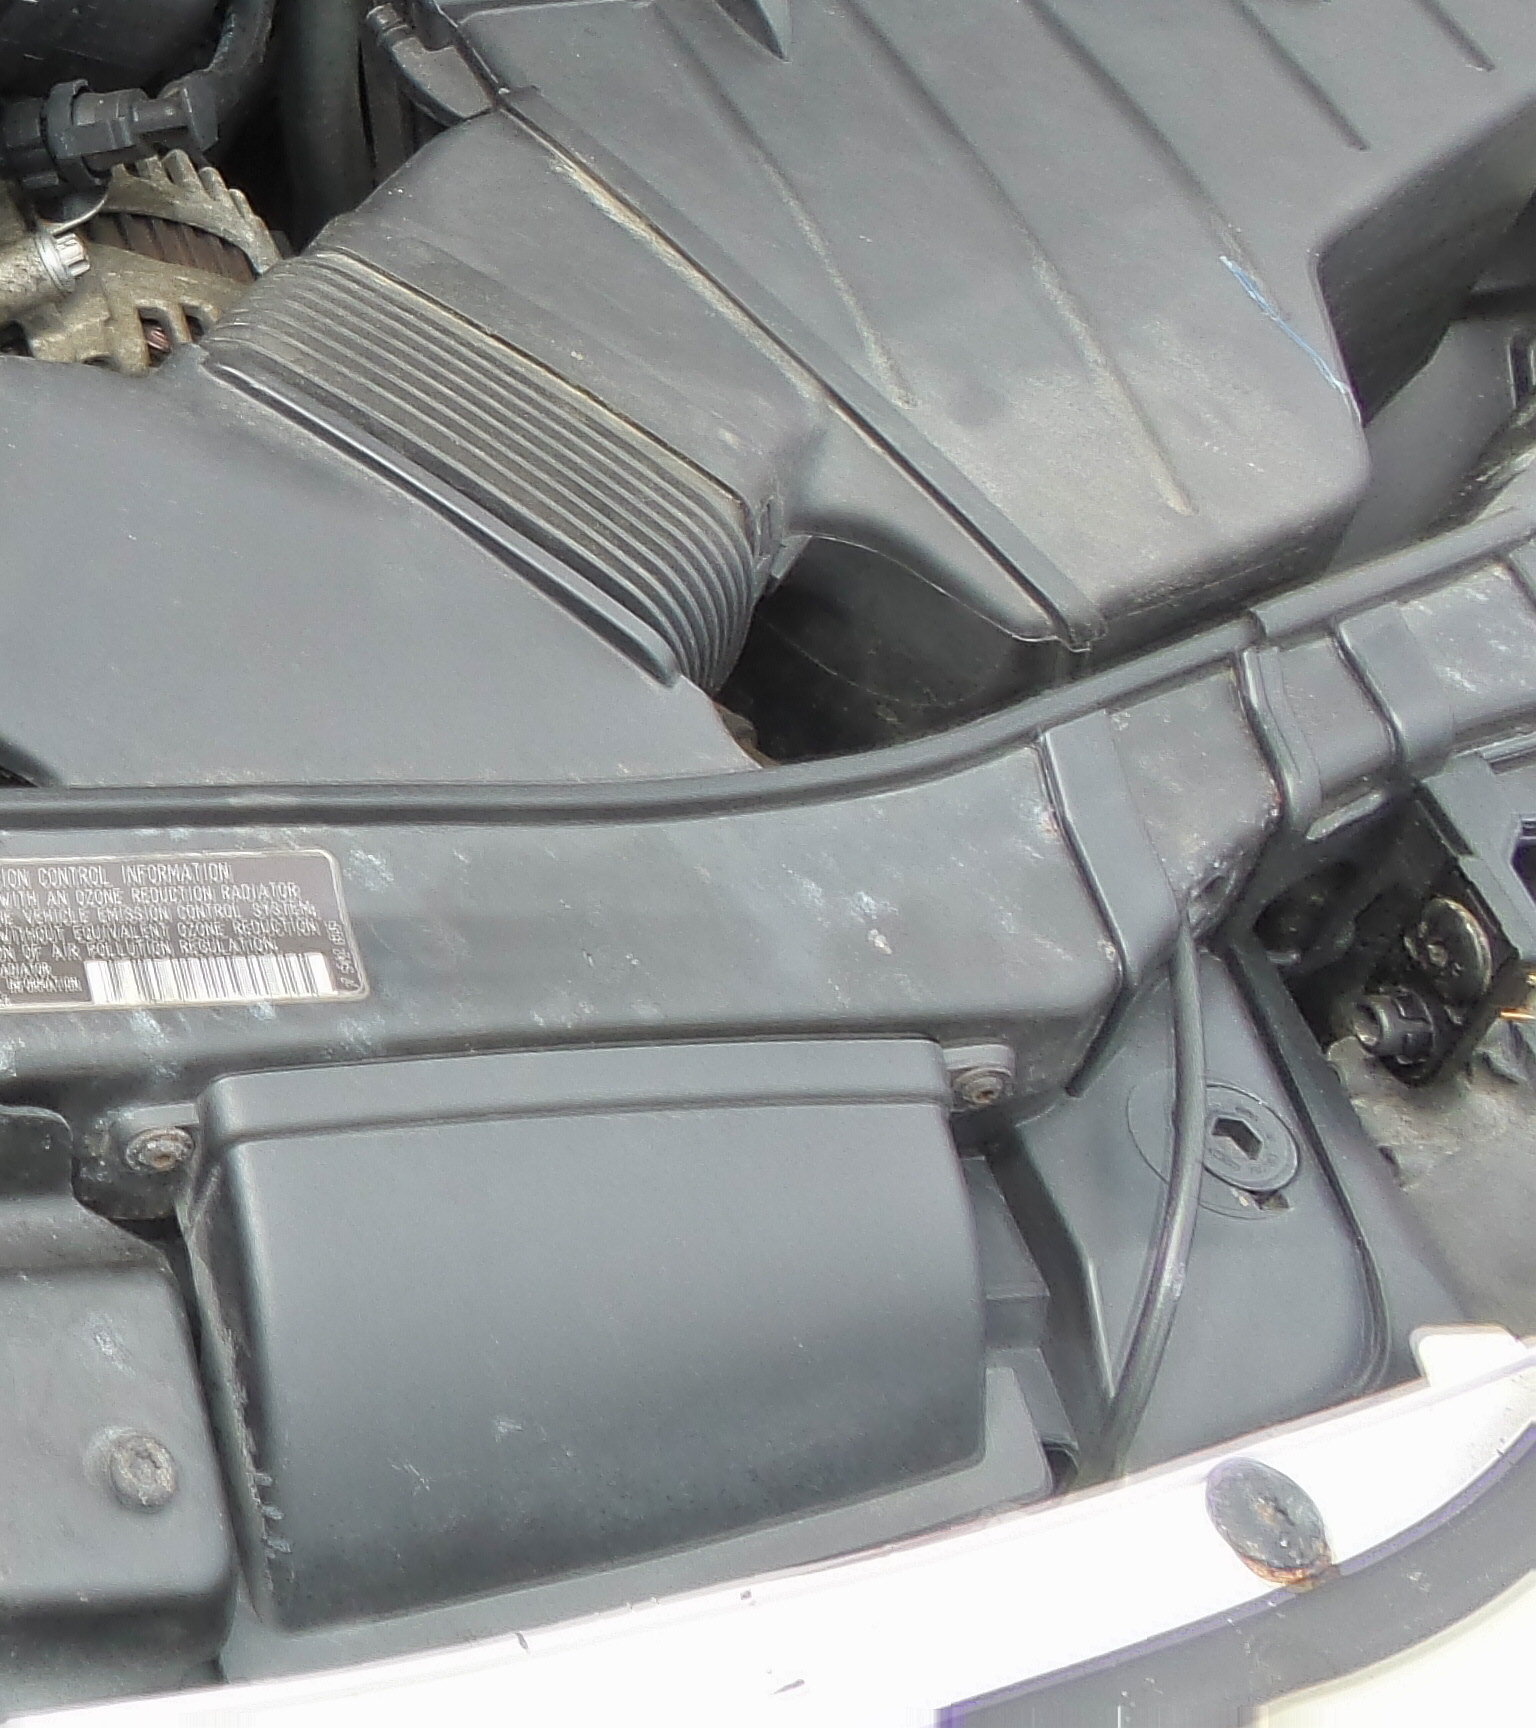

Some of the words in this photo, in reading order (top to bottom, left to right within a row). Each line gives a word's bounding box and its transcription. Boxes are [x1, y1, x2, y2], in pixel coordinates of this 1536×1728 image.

[38, 865, 111, 887] CONTROL
[121, 862, 231, 883] INFORMATION
[47, 890, 69, 906] AN
[76, 888, 123, 906] OZONE
[132, 885, 214, 903] REDUCTION
[23, 907, 90, 925] VEHICLE
[97, 904, 172, 923] EMISSION
[177, 903, 242, 921] CONTROL
[73, 922, 170, 943] EQUIVALENT
[178, 921, 226, 937] OZONE
[233, 920, 322, 937] REDUCTION
[22, 945, 41, 962] OF
[52, 943, 82, 961] AIR
[87, 939, 173, 960] POLLUTION
[6, 975, 82, 993] INFORMATION
